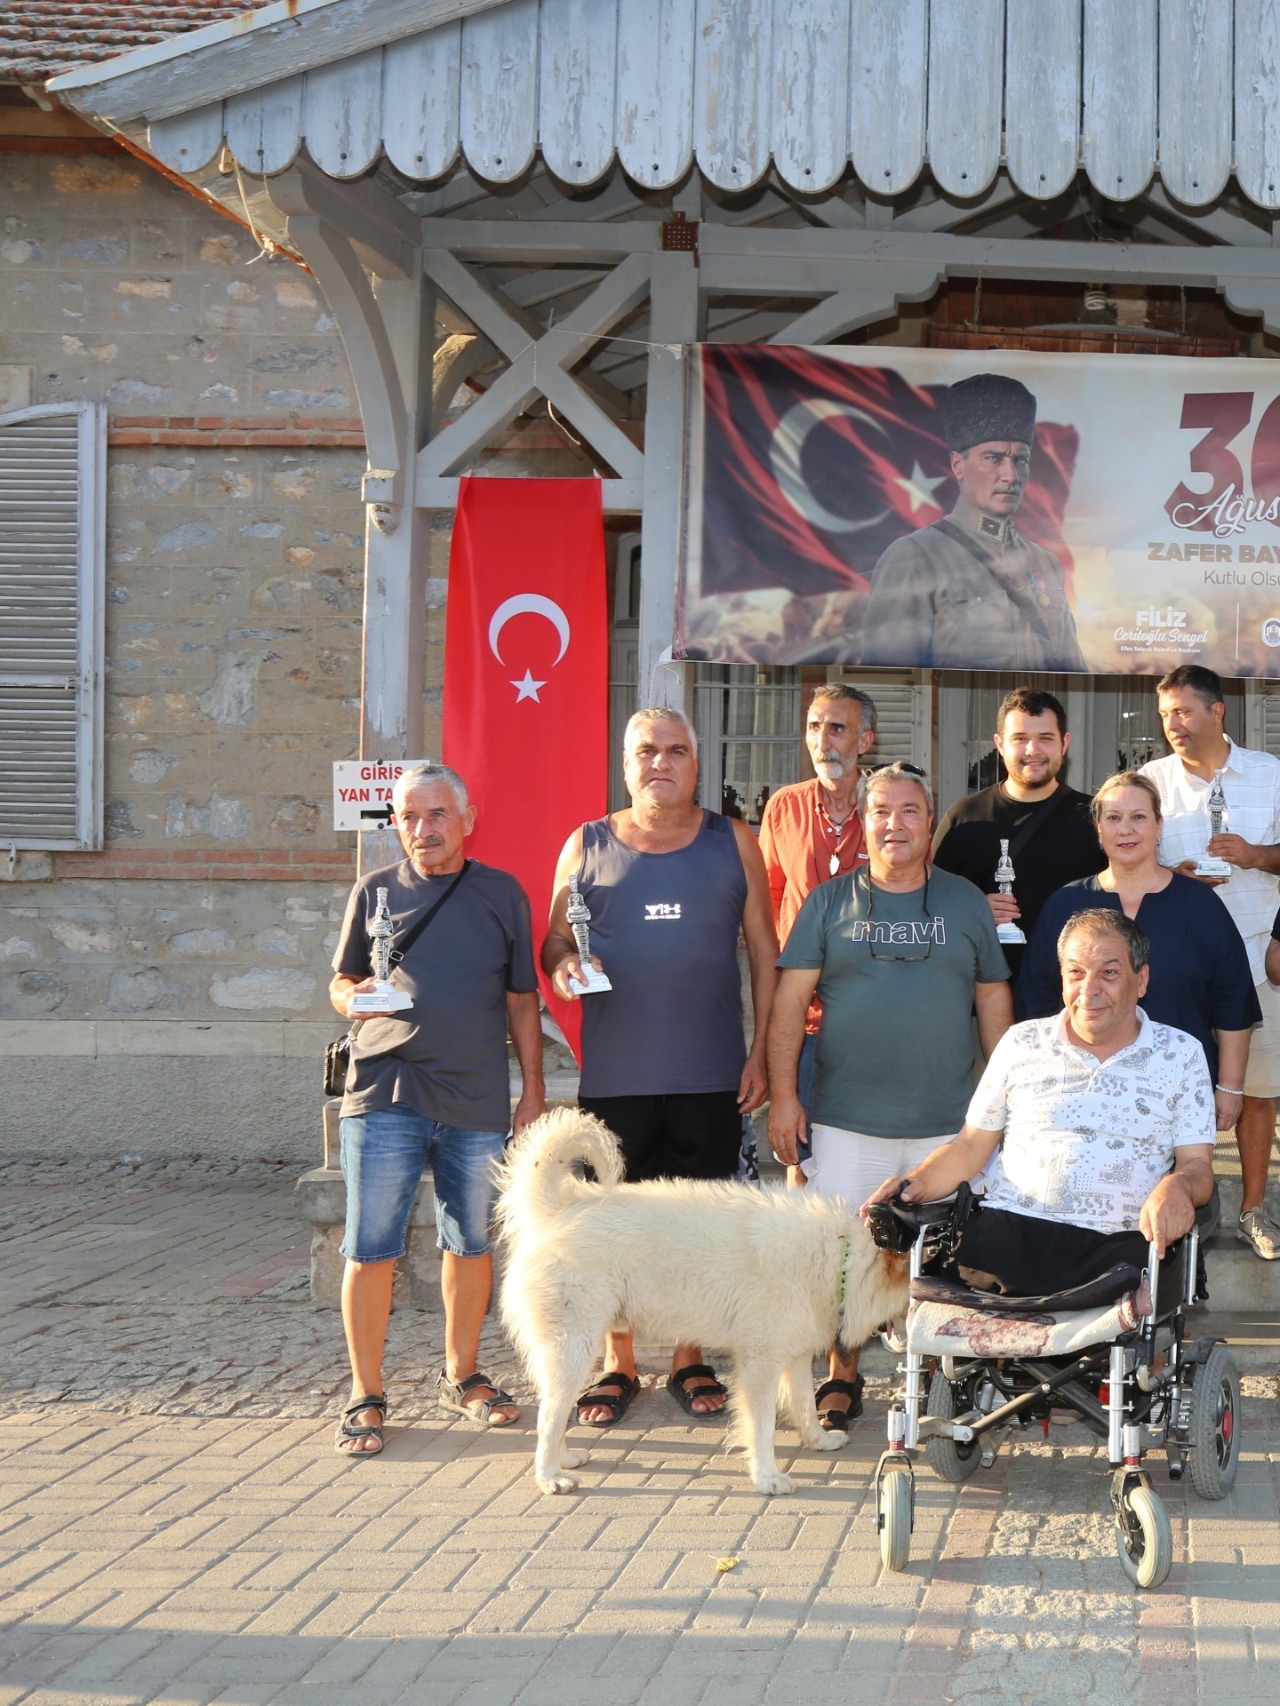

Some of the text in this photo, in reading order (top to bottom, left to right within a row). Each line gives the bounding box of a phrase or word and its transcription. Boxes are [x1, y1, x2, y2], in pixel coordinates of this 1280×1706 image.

[1148, 542, 1233, 563] ZAFER
[1204, 570, 1246, 586] Kutlu
[1136, 605, 1187, 628] FİLİZ
[338, 788, 370, 802] YAN
[852, 916, 946, 945] mavi
